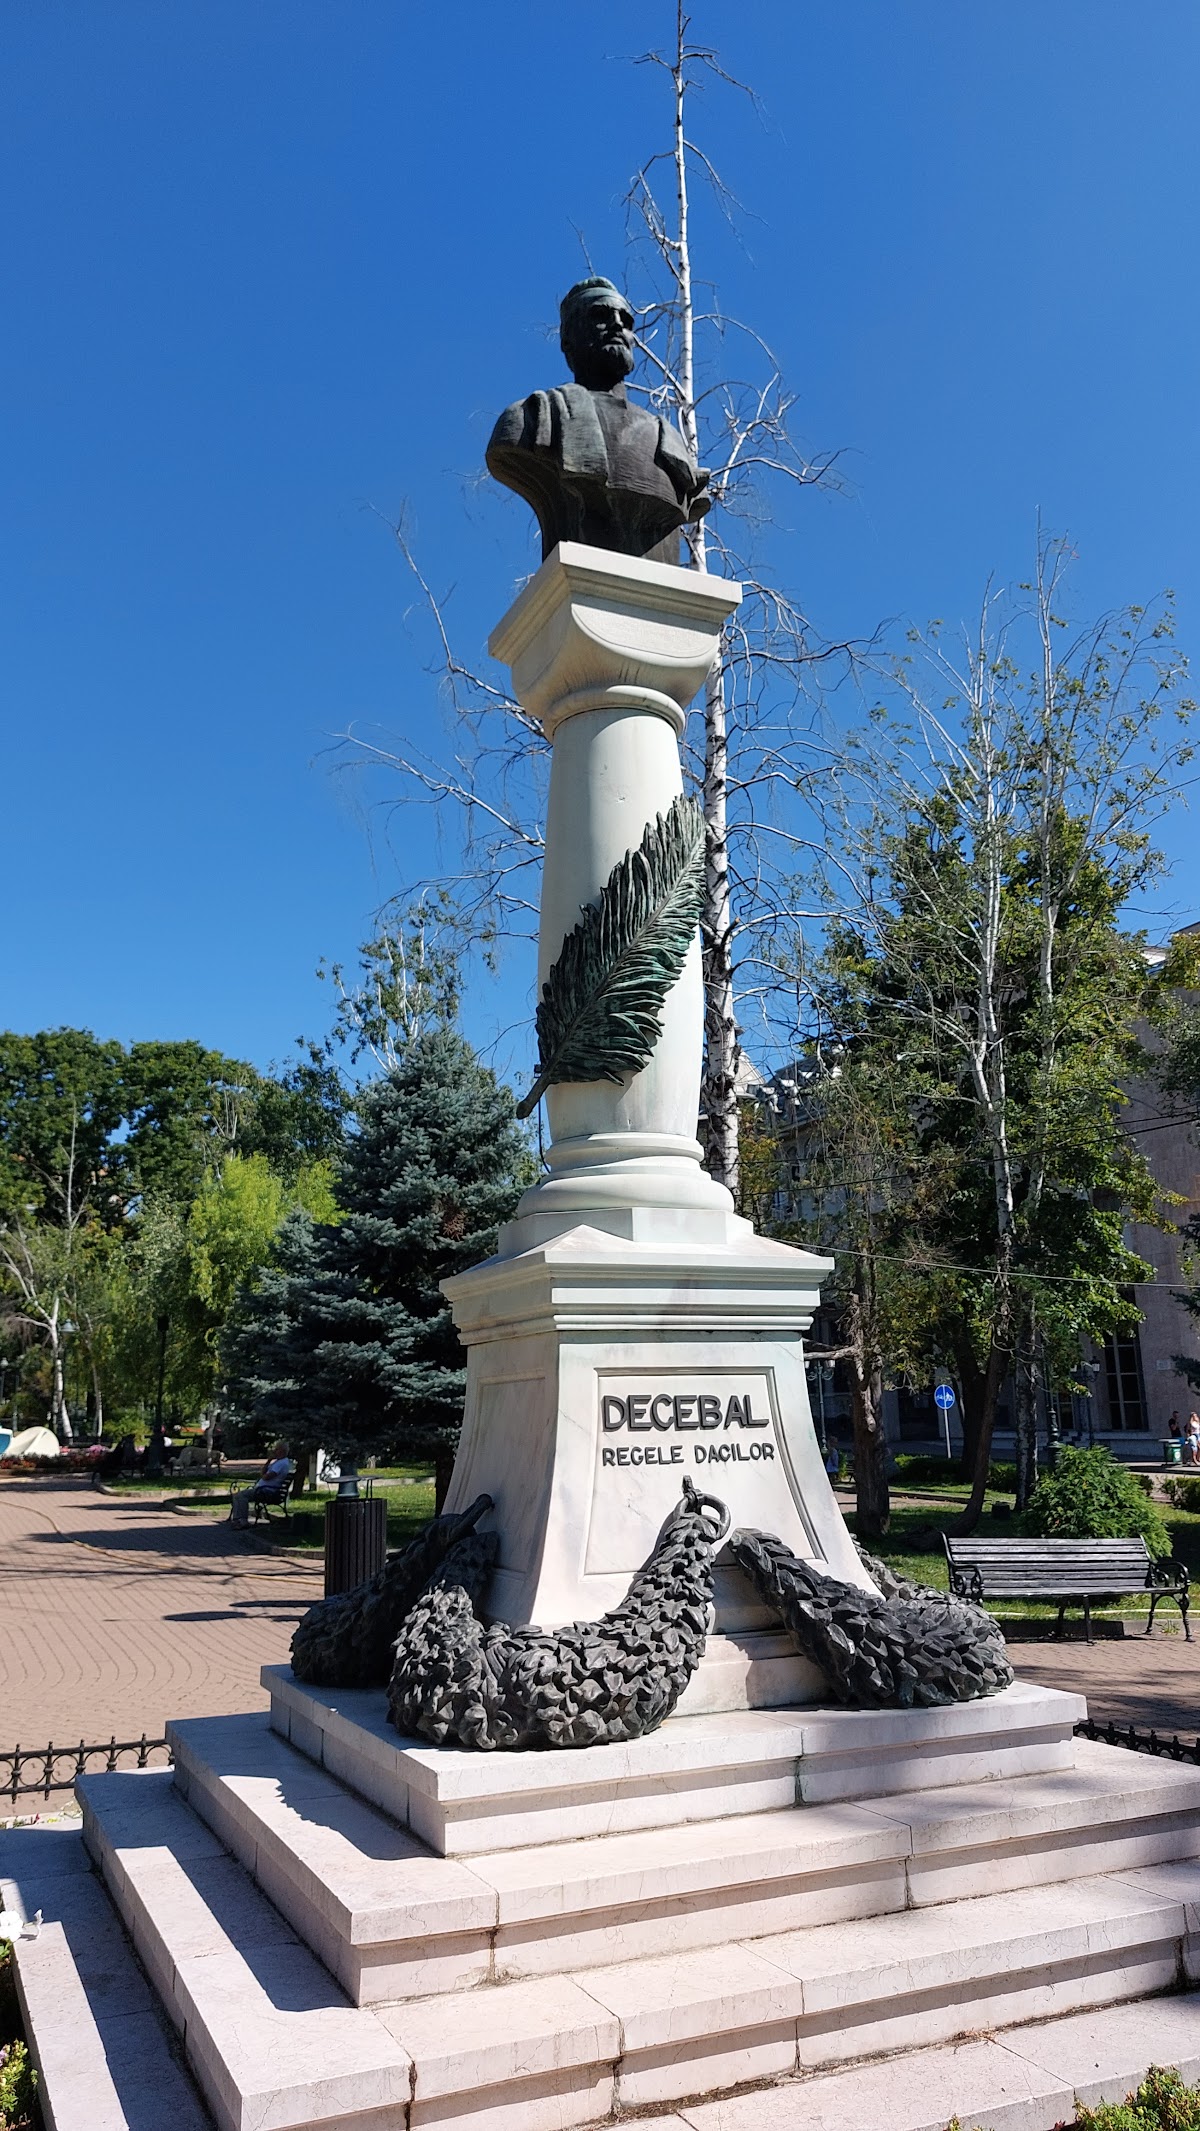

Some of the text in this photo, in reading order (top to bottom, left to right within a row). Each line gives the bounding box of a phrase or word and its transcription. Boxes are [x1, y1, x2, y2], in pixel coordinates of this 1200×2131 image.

[601, 1394, 769, 1432] DECEBAL
[602, 1443, 775, 1466] REGELE DACILOR
